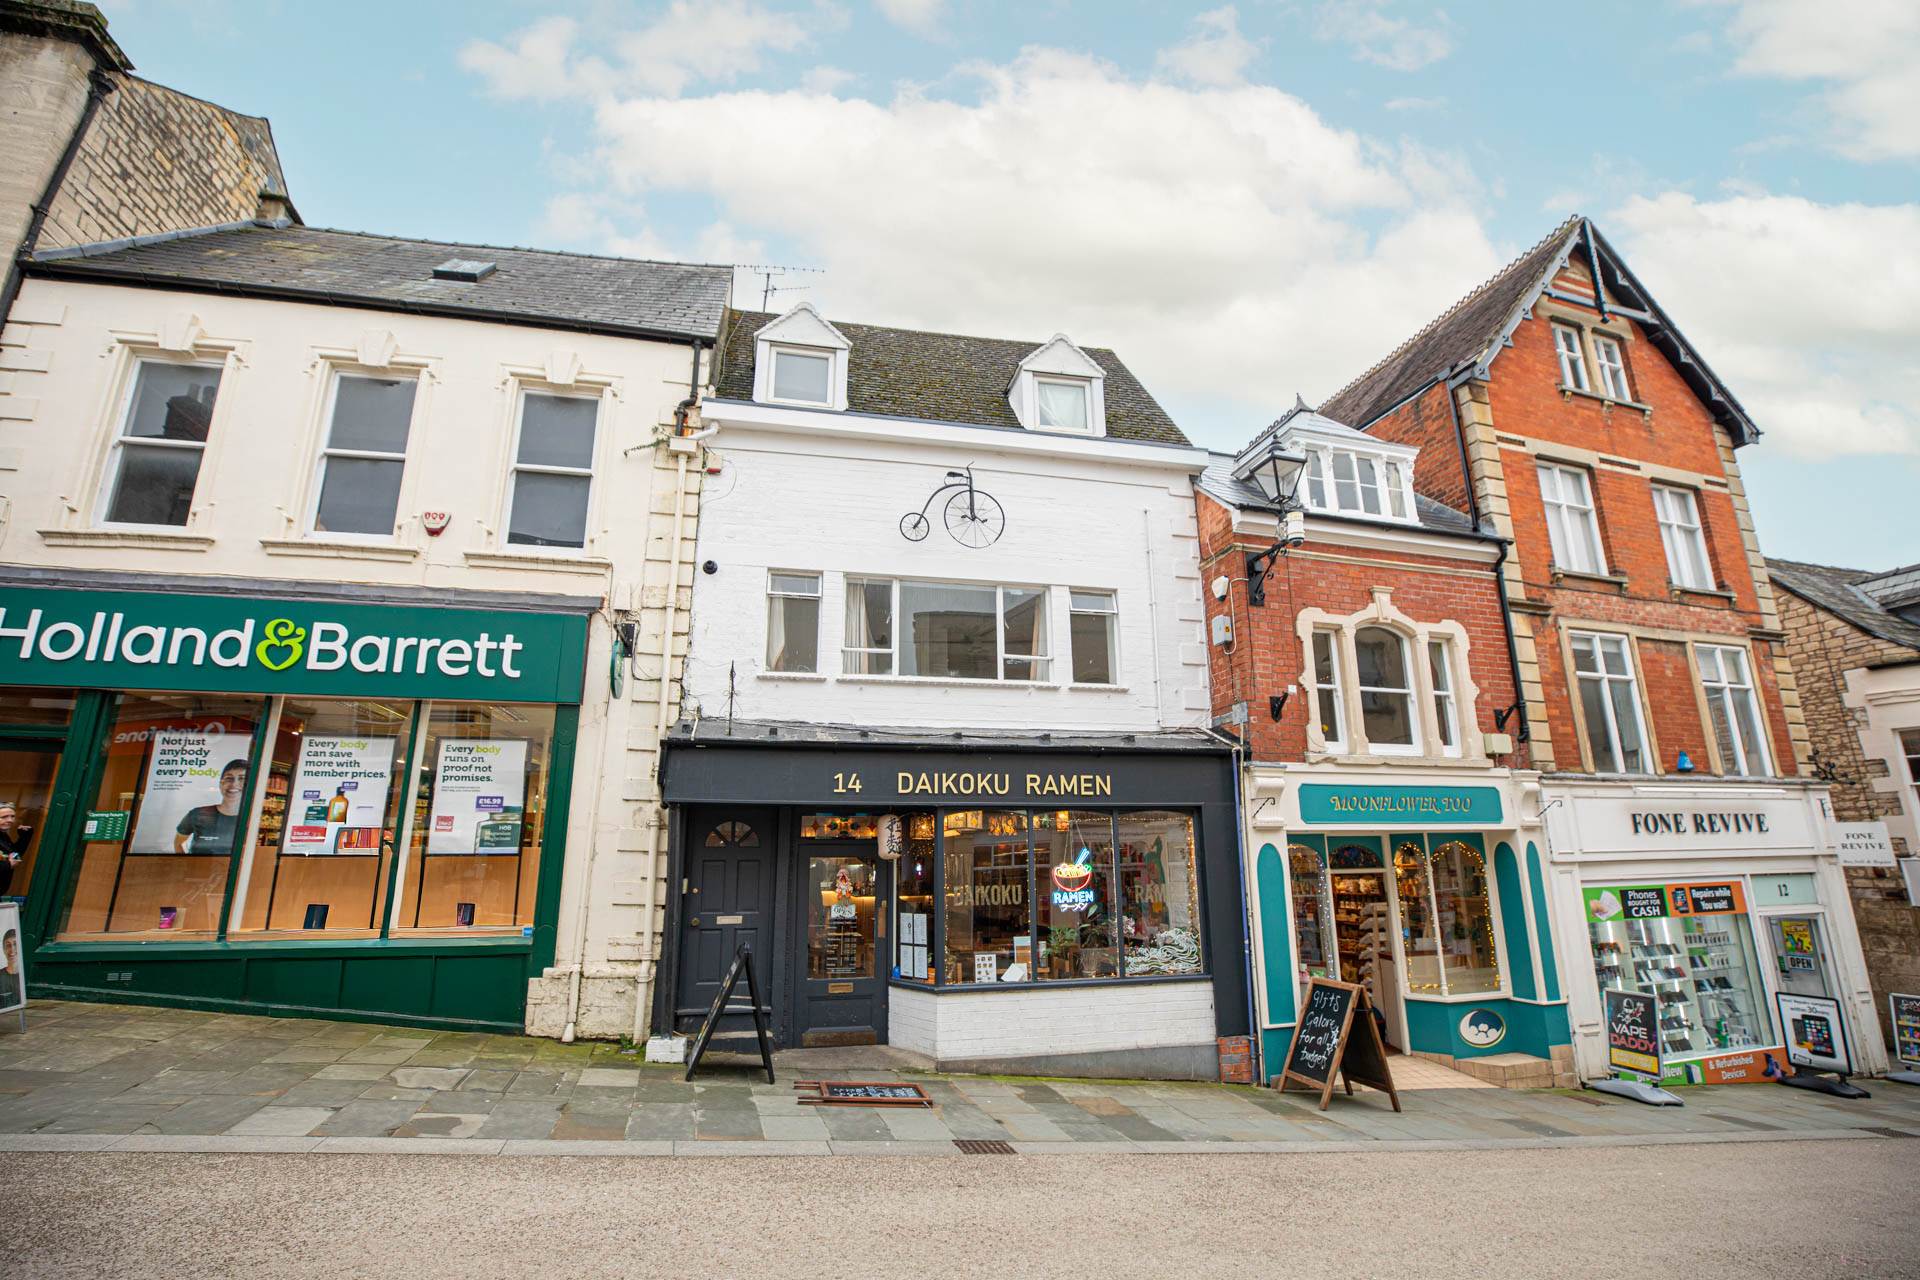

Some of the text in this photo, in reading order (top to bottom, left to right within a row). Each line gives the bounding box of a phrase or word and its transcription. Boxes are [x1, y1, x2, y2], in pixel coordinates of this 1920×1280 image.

[0, 607, 255, 667] Holland
[306, 622, 523, 678] Barrett
[162, 737, 205, 748] Not just
[308, 739, 368, 750] Every body
[160, 748, 210, 757] anybody
[329, 750, 353, 758] save
[446, 745, 501, 755] Every body
[158, 757, 207, 768] can help
[337, 759, 360, 768] with
[156, 767, 220, 778] every body.
[303, 768, 387, 779] member prices.
[443, 764, 492, 773] proof not
[442, 772, 493, 783] promises.
[833, 771, 1113, 796] 14 DAIKOKU RAMEN
[1330, 796, 1472, 814] MOONFLOWER TOO
[1632, 813, 1770, 834] FONE REVIVE
[1841, 842, 1886, 850] REVIVE
[1628, 891, 1657, 899] Phones
[1692, 887, 1731, 898] Repairs while
[1778, 884, 1789, 896] 12
[953, 885, 1022, 907] DAIKOKU
[1053, 891, 1094, 904] RAMEN
[1700, 900, 1713, 910] You
[1632, 906, 1661, 917] CASH
[1790, 957, 1812, 968] OPEN
[1612, 1023, 1648, 1040] VAPE
[1299, 1029, 1330, 1046] for all
[1610, 1033, 1656, 1052] DADDY
[1708, 1054, 1754, 1070] & Refurbished
[1664, 1065, 1682, 1077] New
[1721, 1069, 1747, 1080] Devices
